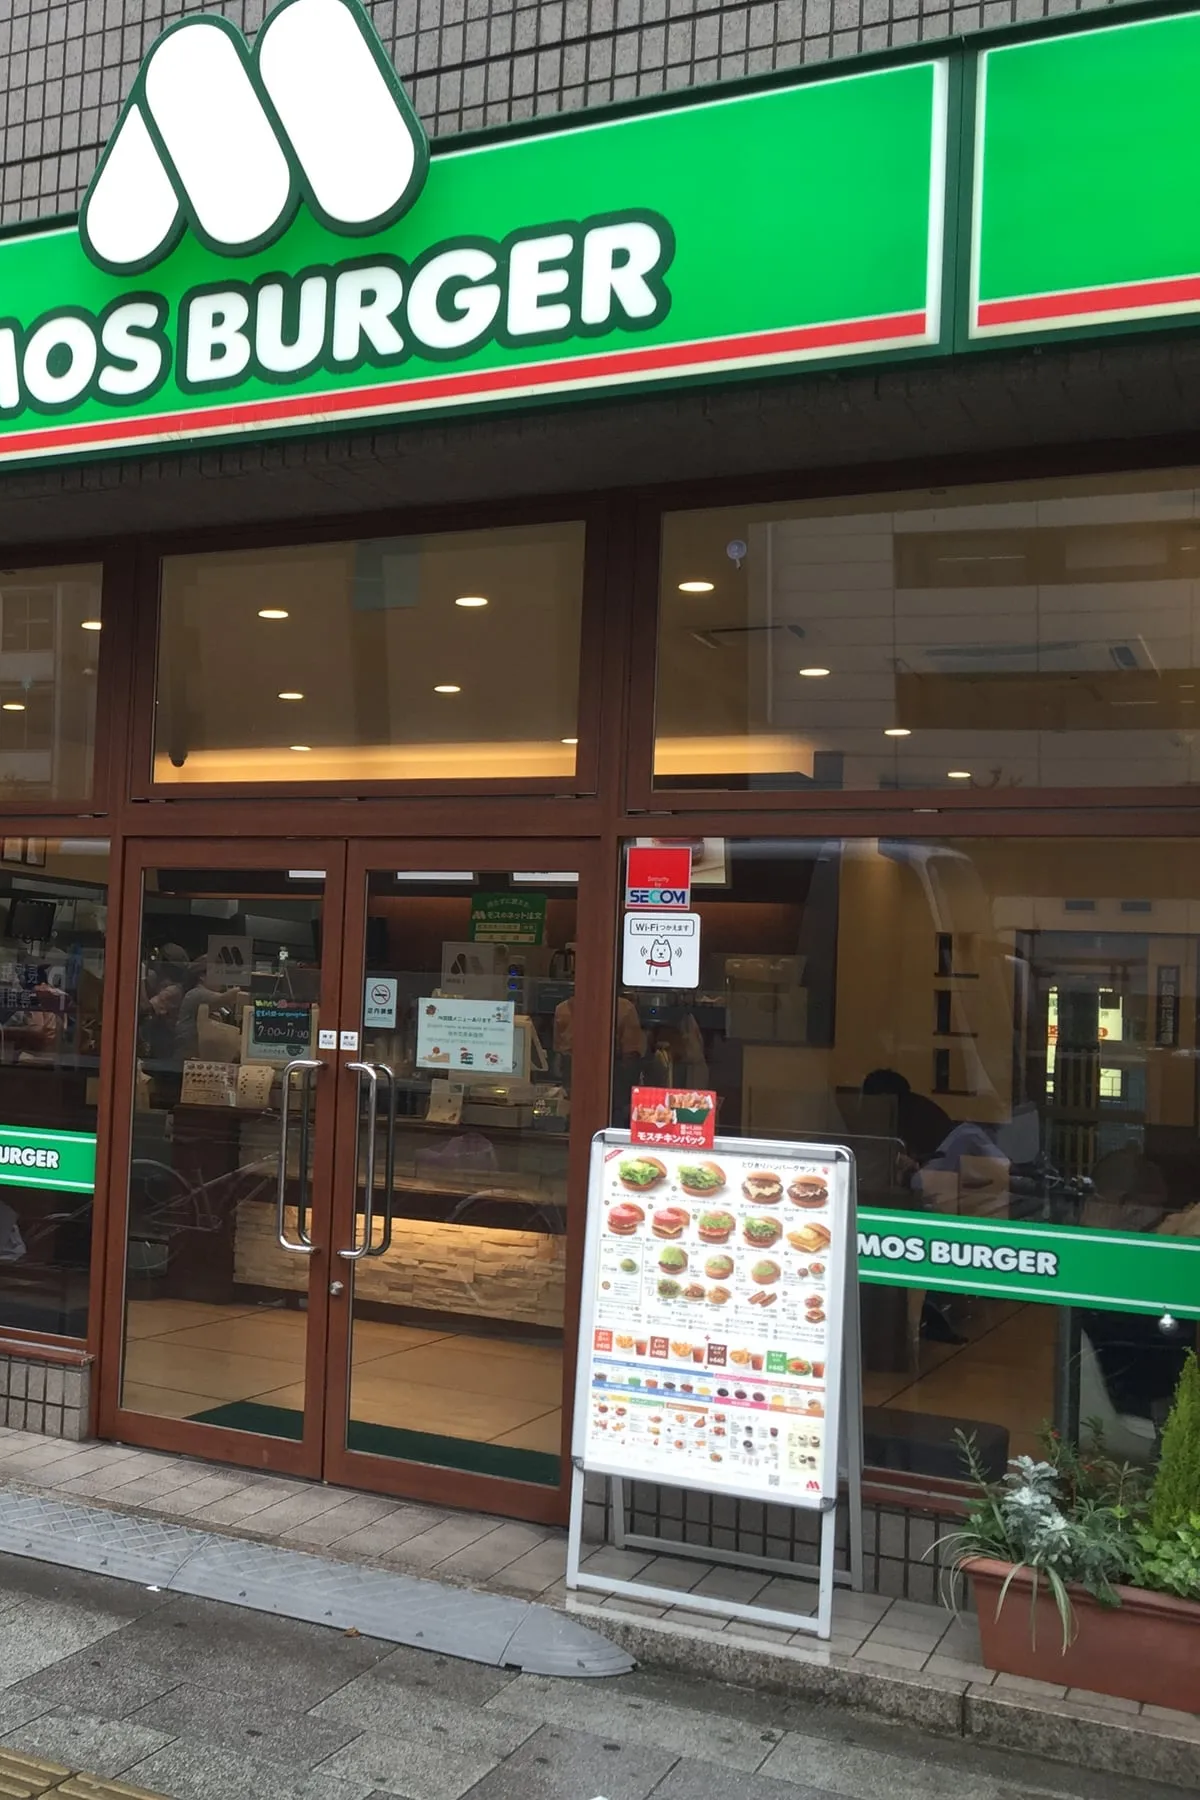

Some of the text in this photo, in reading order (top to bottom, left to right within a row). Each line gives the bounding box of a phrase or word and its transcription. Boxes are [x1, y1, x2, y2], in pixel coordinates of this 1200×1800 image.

[185, 219, 664, 385] BURGER
[630, 889, 686, 904] SECOM
[637, 1131, 706, 1146] モスチキンパック
[857, 1233, 1058, 1276] MOS BURGER
